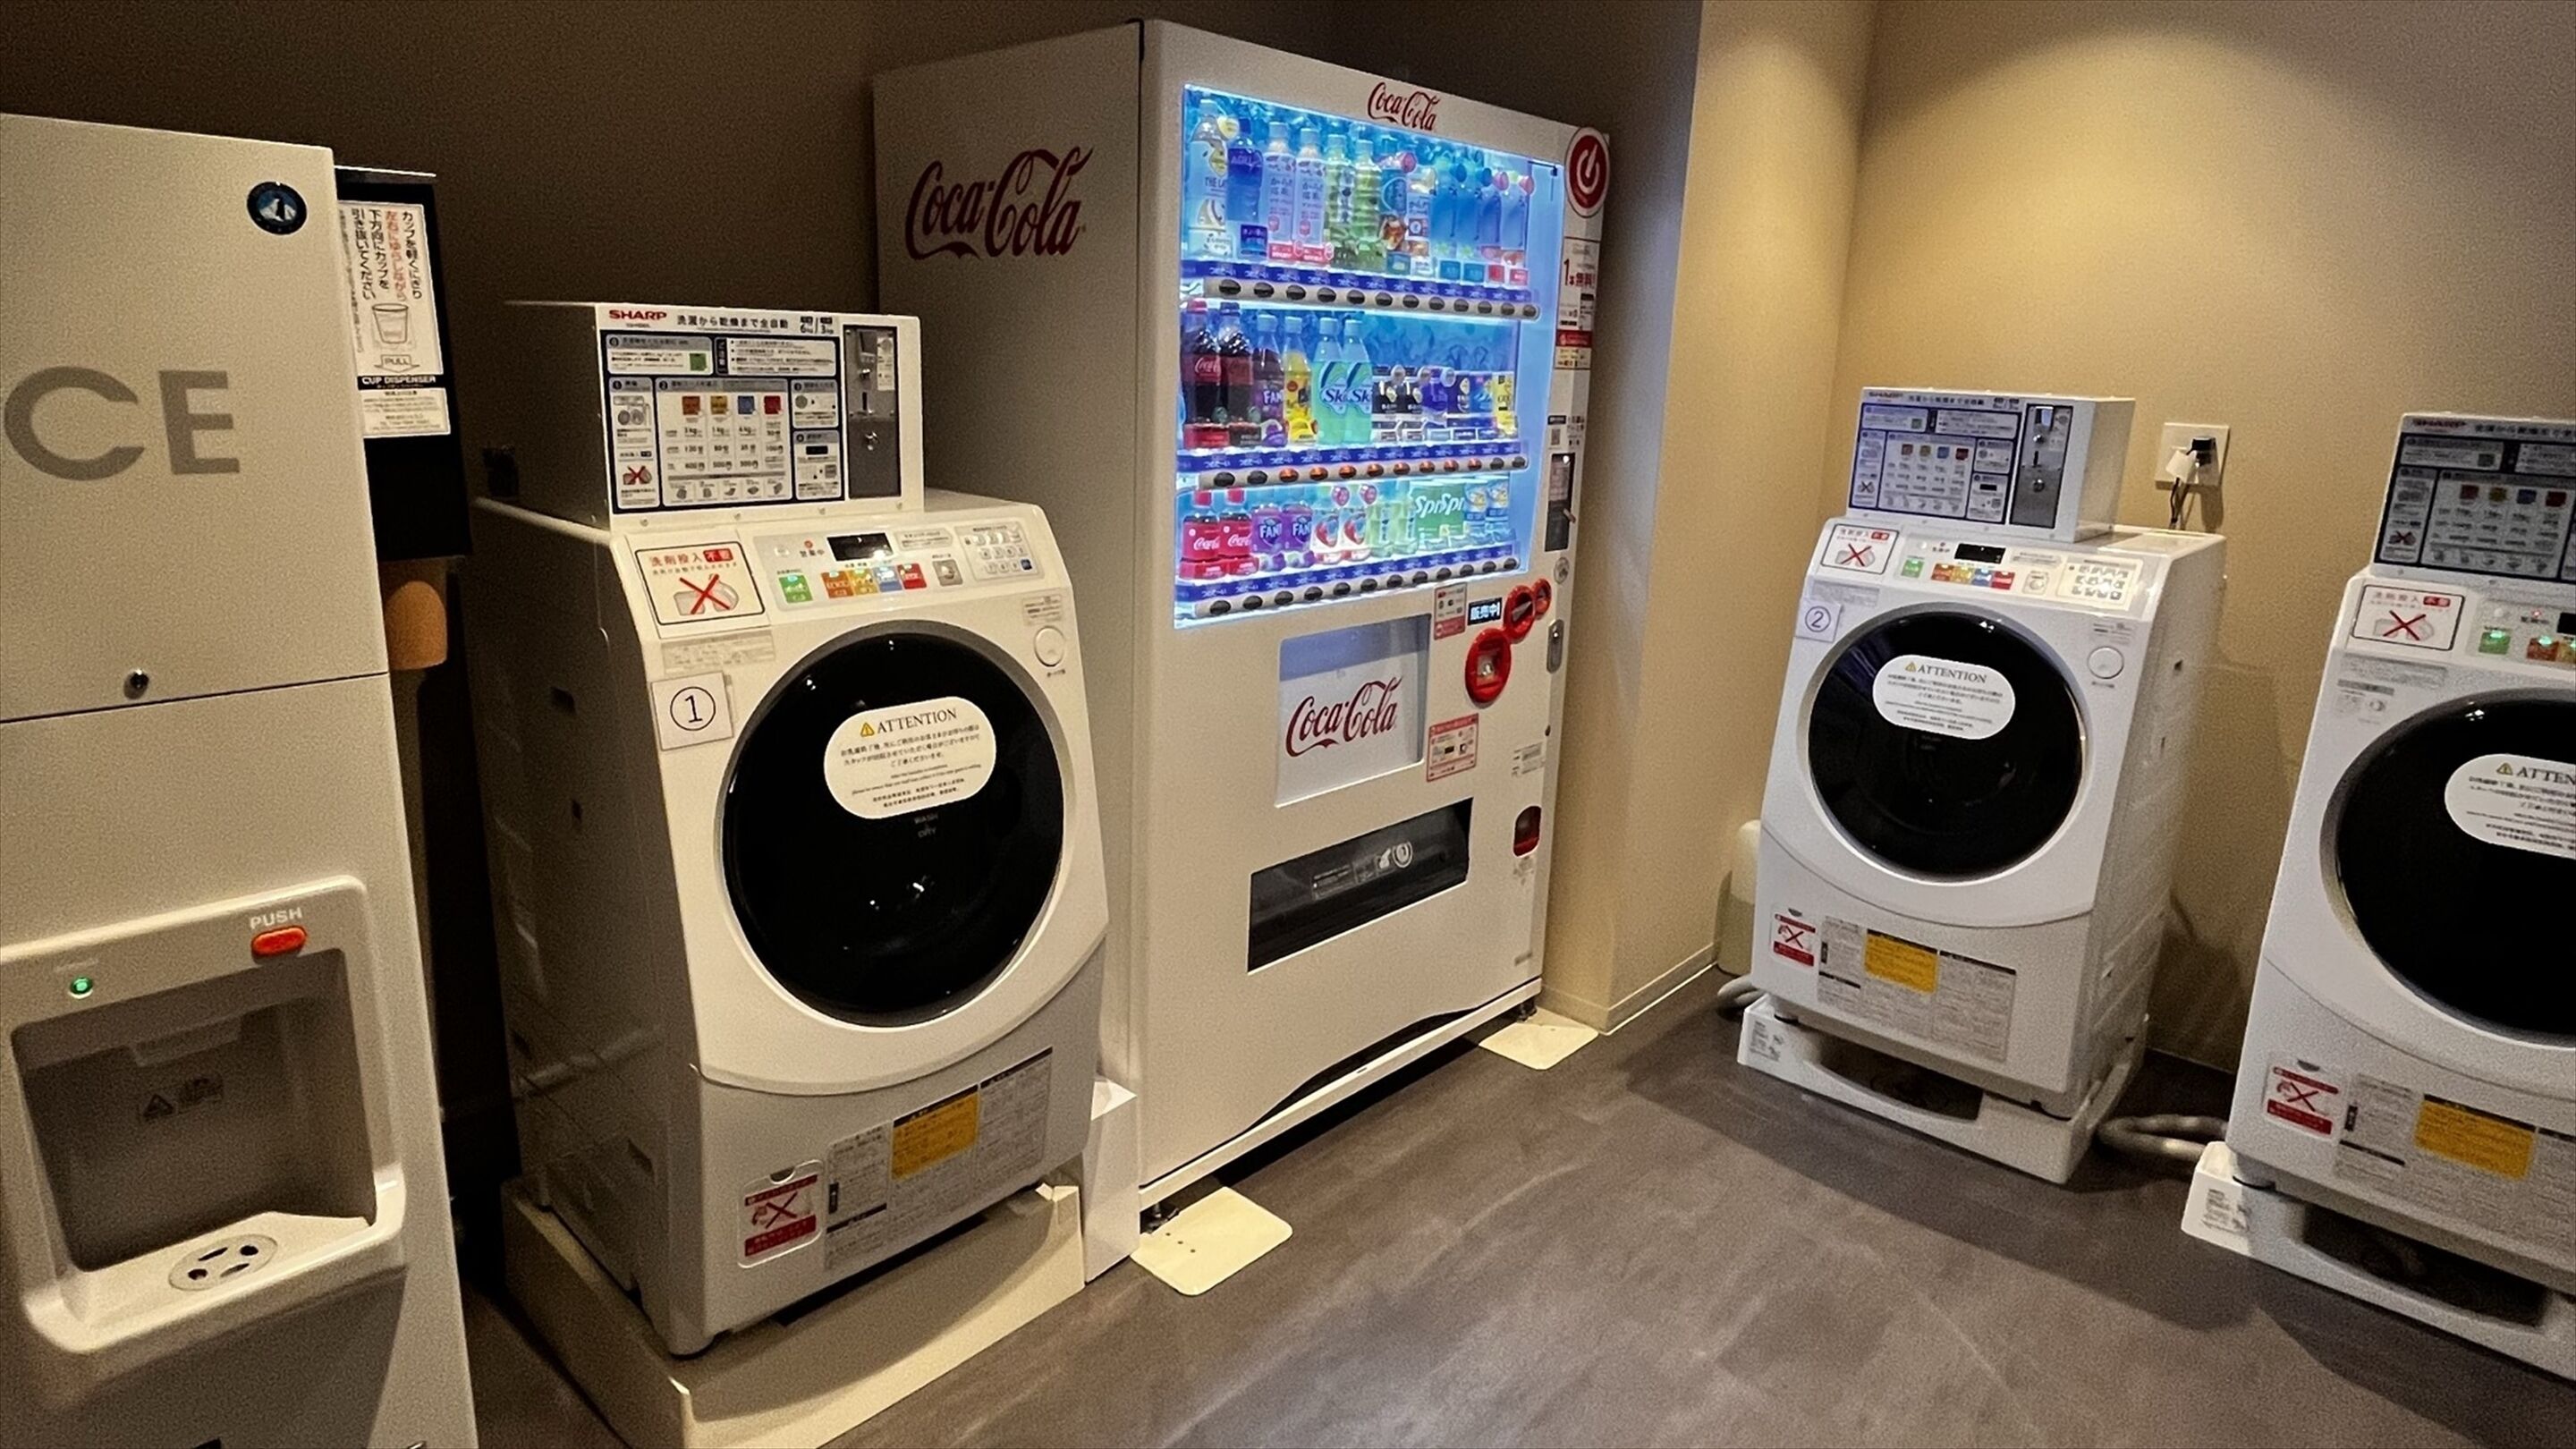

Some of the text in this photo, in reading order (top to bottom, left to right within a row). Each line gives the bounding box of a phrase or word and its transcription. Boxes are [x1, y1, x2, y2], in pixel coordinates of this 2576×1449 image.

[1367, 81, 1441, 131] Coca-Cola
[905, 145, 1094, 259] Coca-Cola
[609, 309, 667, 320] SHARP
[384, 358, 411, 366] PULL
[361, 375, 436, 386] CUP DISPENSER
[4, 366, 240, 480] CE
[1918, 665, 1987, 684] ATTENTION
[877, 708, 959, 734] ATTENTION
[1285, 674, 1402, 757] Coca-Cola
[250, 907, 303, 930] PUSH
